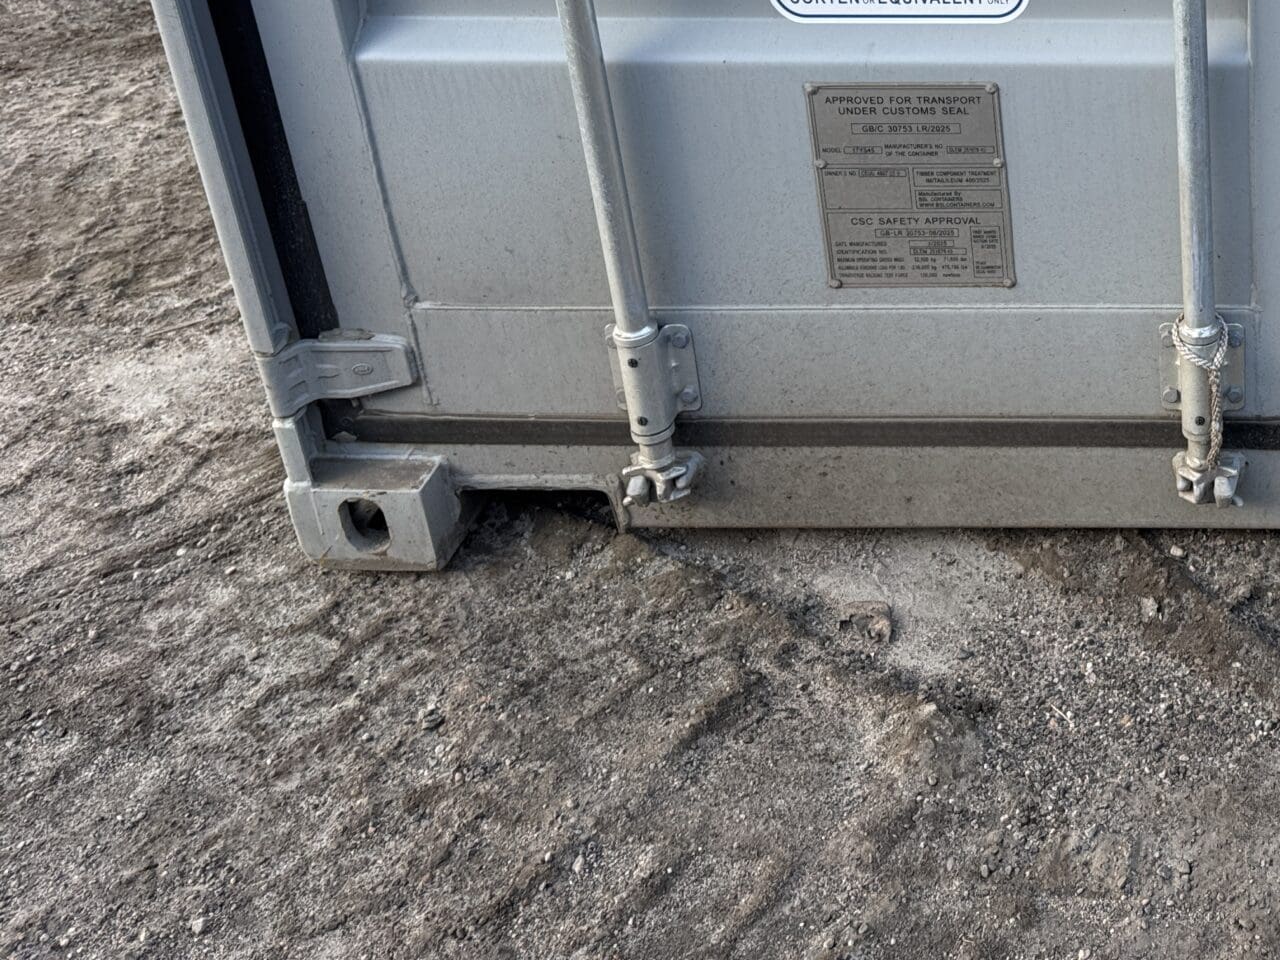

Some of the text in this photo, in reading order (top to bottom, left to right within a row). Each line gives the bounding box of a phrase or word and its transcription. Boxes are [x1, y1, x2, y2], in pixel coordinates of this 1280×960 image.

[824, 96, 982, 104] APPROVED FOR TRANSPORT
[838, 107, 969, 115] UNDER CUSTOMS SEAL
[861, 125, 951, 133] GB/C 30753 LR/2025
[850, 217, 982, 225] CSC SAFETY APPROVAL
